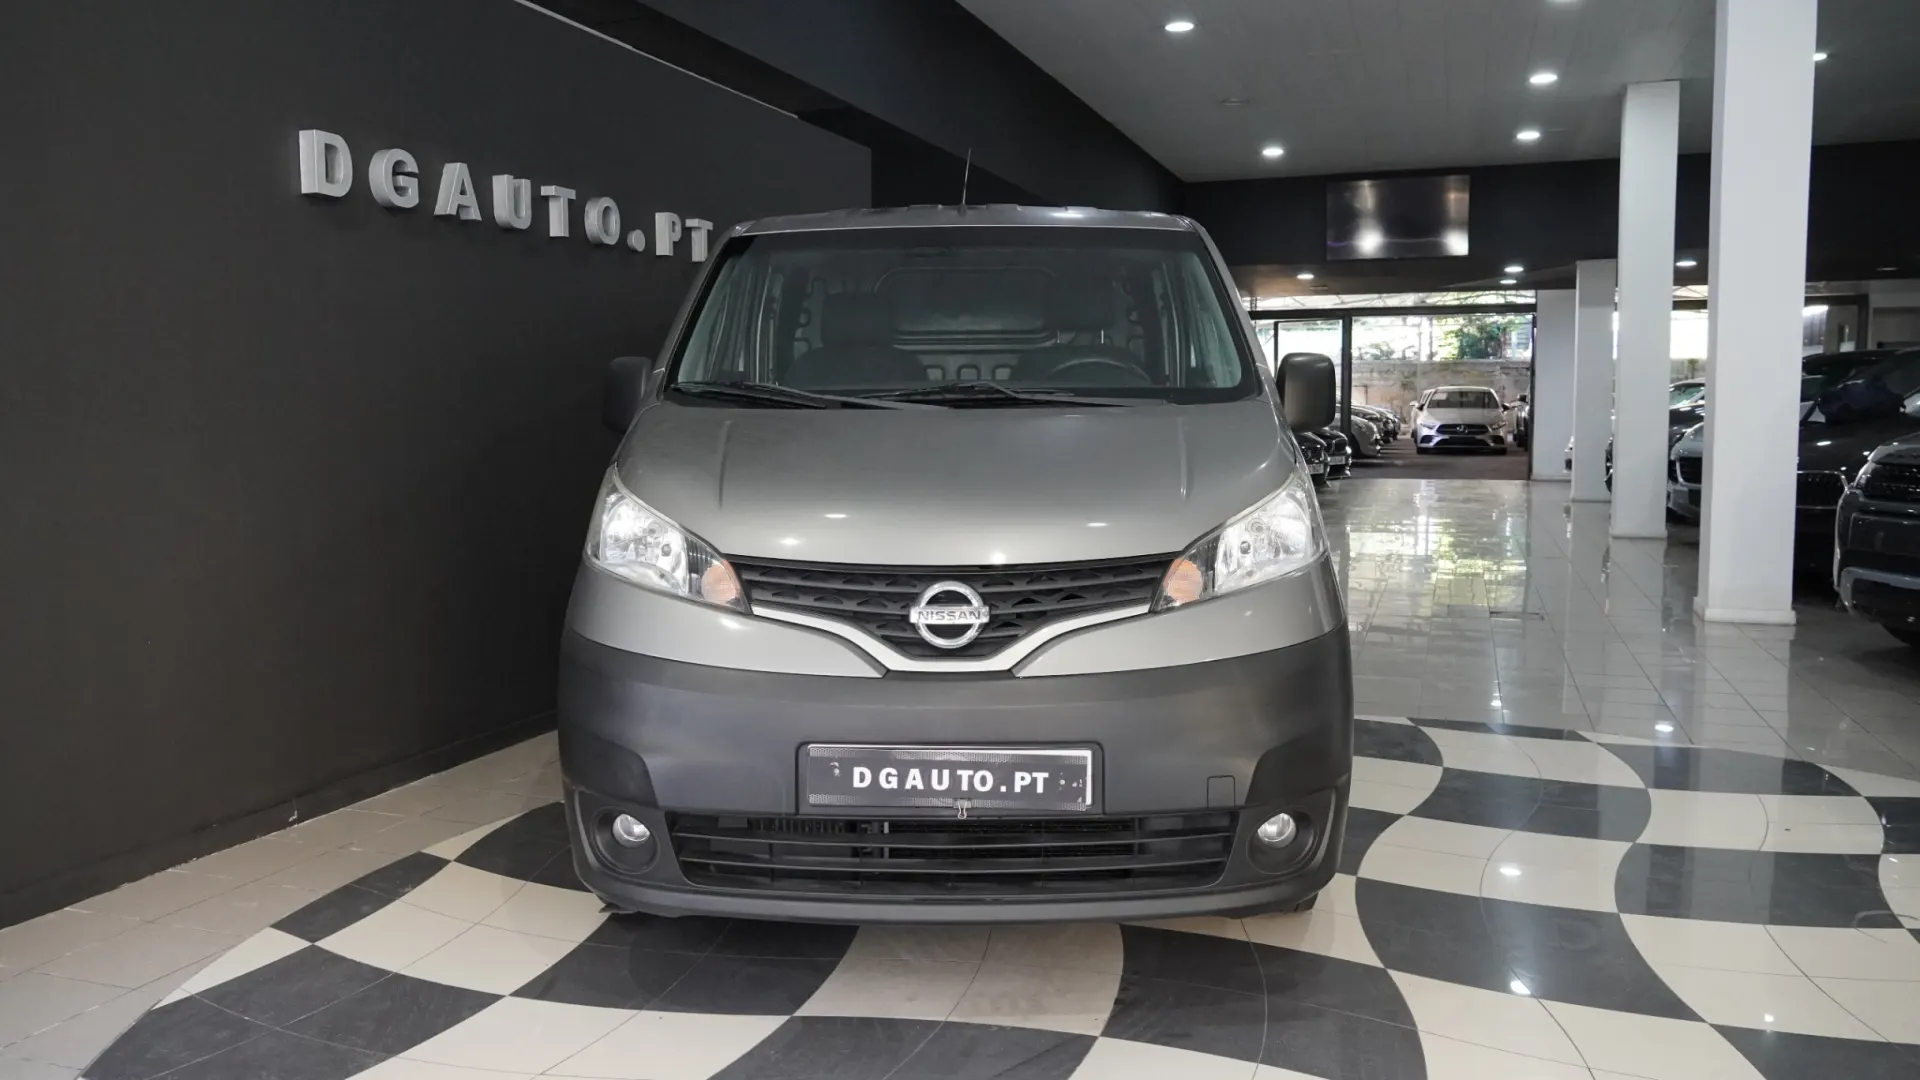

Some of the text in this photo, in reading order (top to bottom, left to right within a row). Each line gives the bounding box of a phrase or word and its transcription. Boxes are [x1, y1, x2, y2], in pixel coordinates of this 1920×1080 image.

[299, 129, 713, 262] DGAUTO.PT
[918, 610, 981, 621] NISSAN
[852, 766, 1049, 794] DGAUTO.PT
